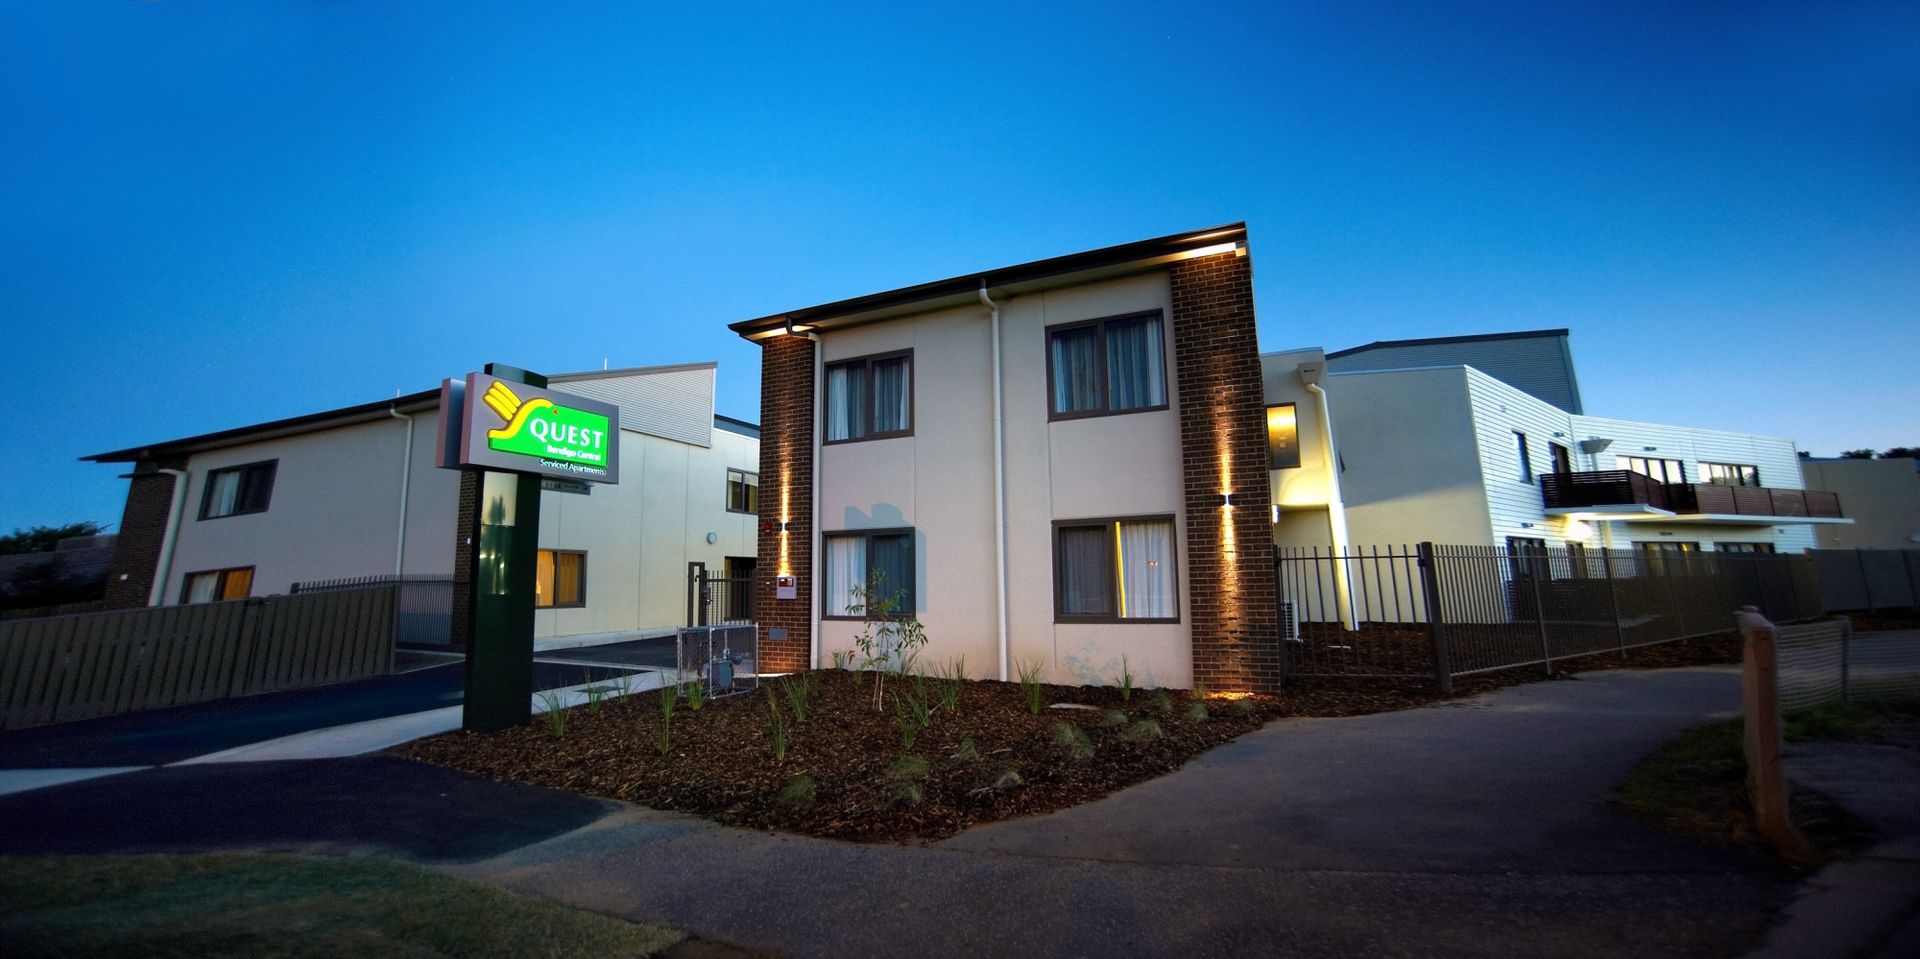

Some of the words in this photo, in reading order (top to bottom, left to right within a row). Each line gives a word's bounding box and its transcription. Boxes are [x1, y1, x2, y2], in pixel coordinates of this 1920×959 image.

[529, 418, 604, 449] QUEST
[546, 444, 577, 458] Bendigo
[577, 447, 601, 461] Central
[540, 458, 569, 470] Serviced
[569, 463, 606, 476] Apartments
